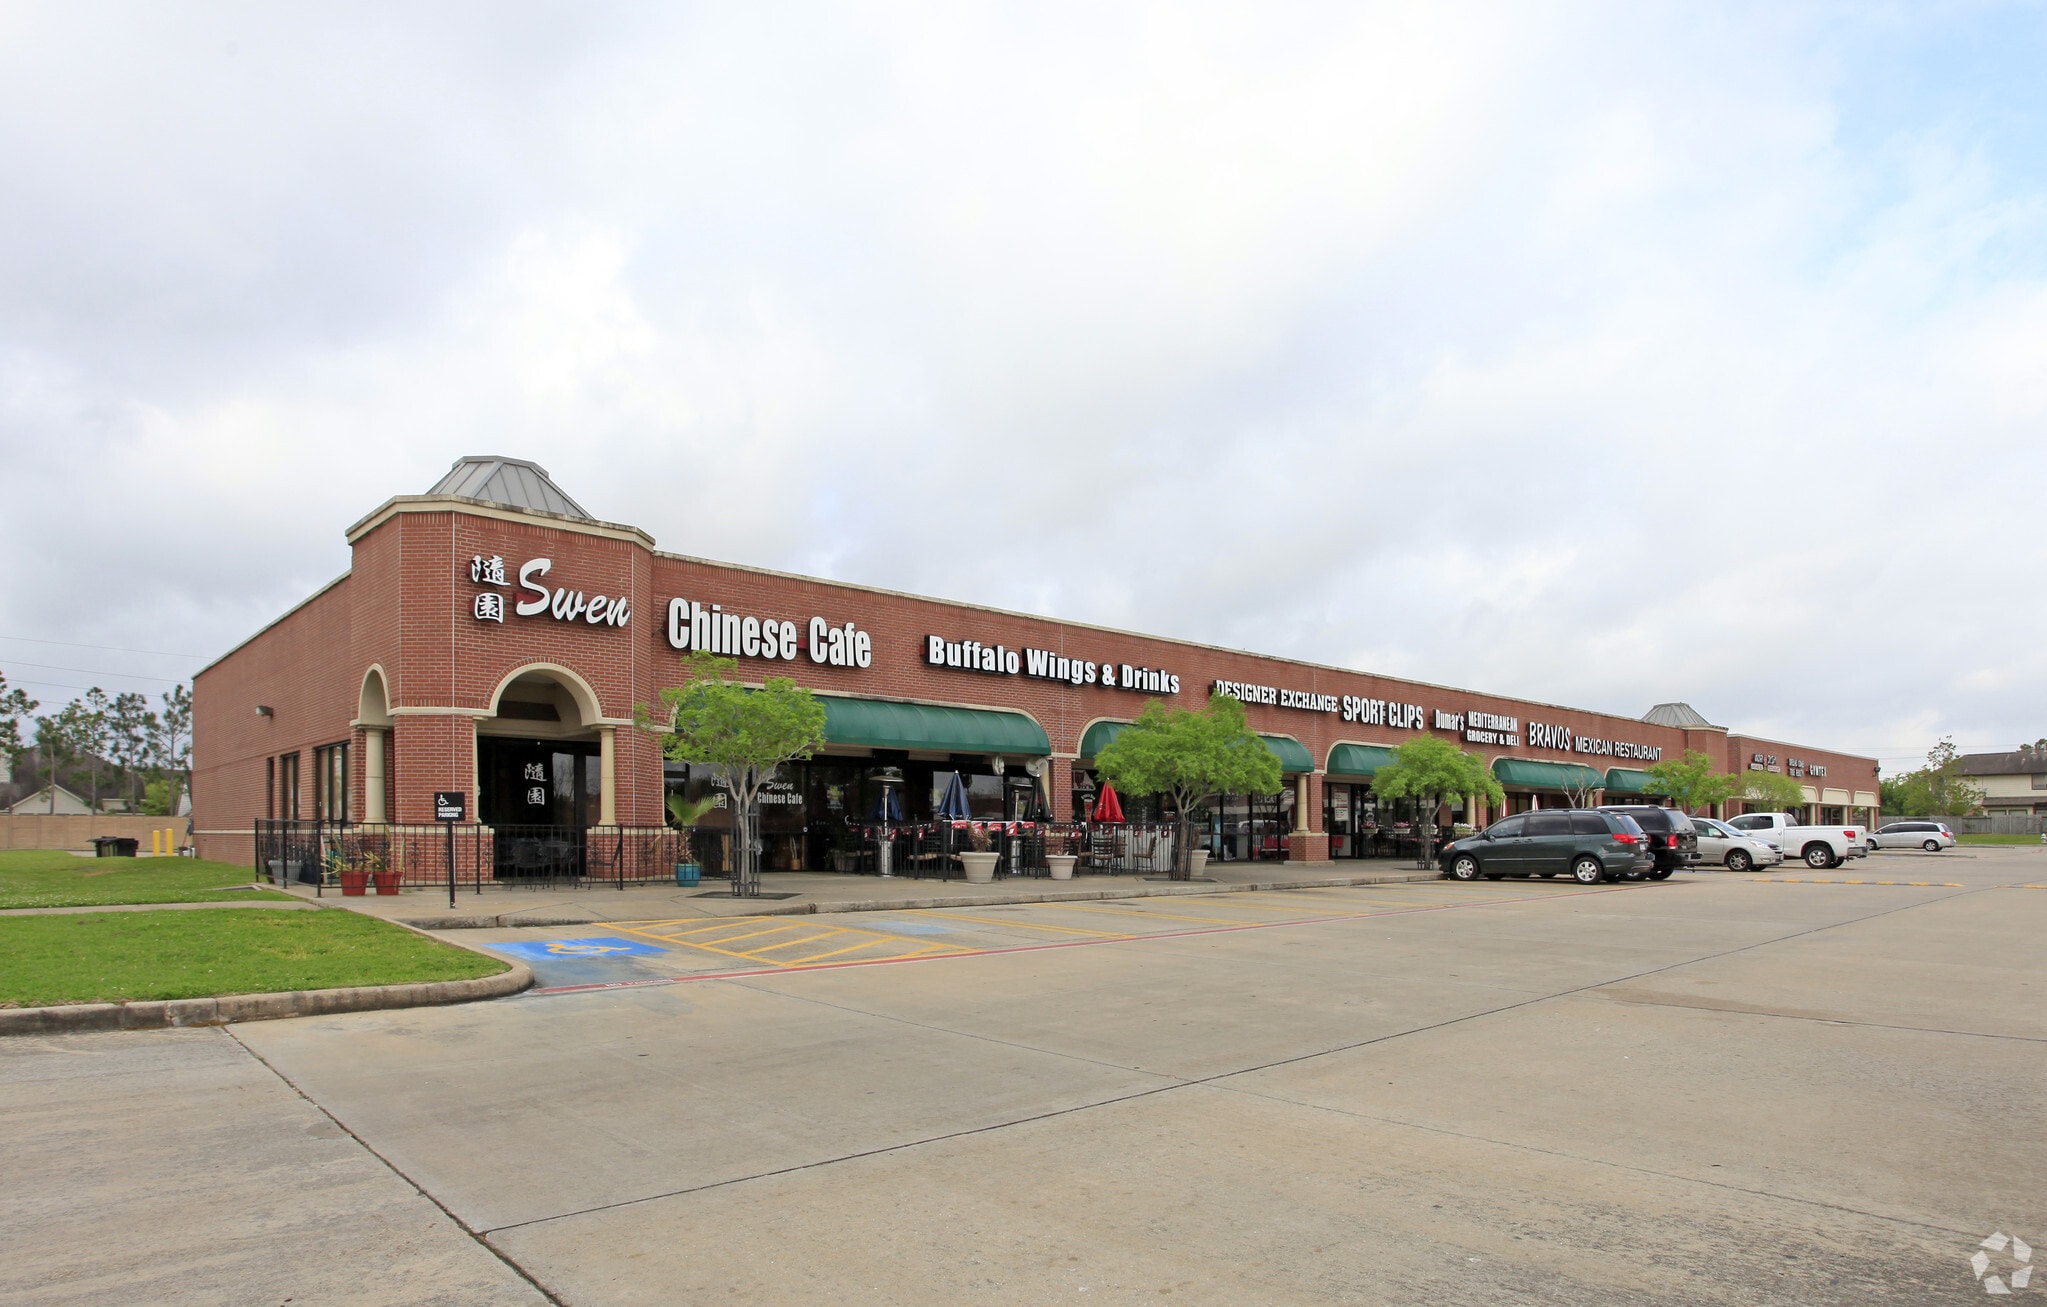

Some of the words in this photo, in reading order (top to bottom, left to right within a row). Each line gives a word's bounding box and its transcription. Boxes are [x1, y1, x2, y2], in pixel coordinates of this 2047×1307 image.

[515, 557, 631, 627] Swen
[668, 597, 798, 661] Chinese
[809, 616, 872, 668] Cafe
[928, 635, 1020, 674] Buffalo
[1026, 648, 1097, 684] Wings
[1102, 663, 1116, 686] &
[1121, 664, 1180, 694] Drinks
[1216, 679, 1277, 705] DESIGNER
[1280, 689, 1338, 713] EXCHANGE
[1343, 695, 1385, 725] SPORT
[1388, 702, 1424, 730] CLIPS
[1468, 711, 1518, 733] MEDITERRANEAN
[1466, 729, 1497, 745] GROCERY
[1499, 733, 1505, 745] &
[1506, 734, 1519, 746] DELI
[1529, 721, 1571, 751] BRAVOS
[1575, 735, 1613, 756] MEXICAN
[1614, 741, 1662, 761] RESTAURANT
[757, 791, 786, 804] Chinese
[787, 792, 803, 805] Cafe
[766, 779, 794, 791] Swen
